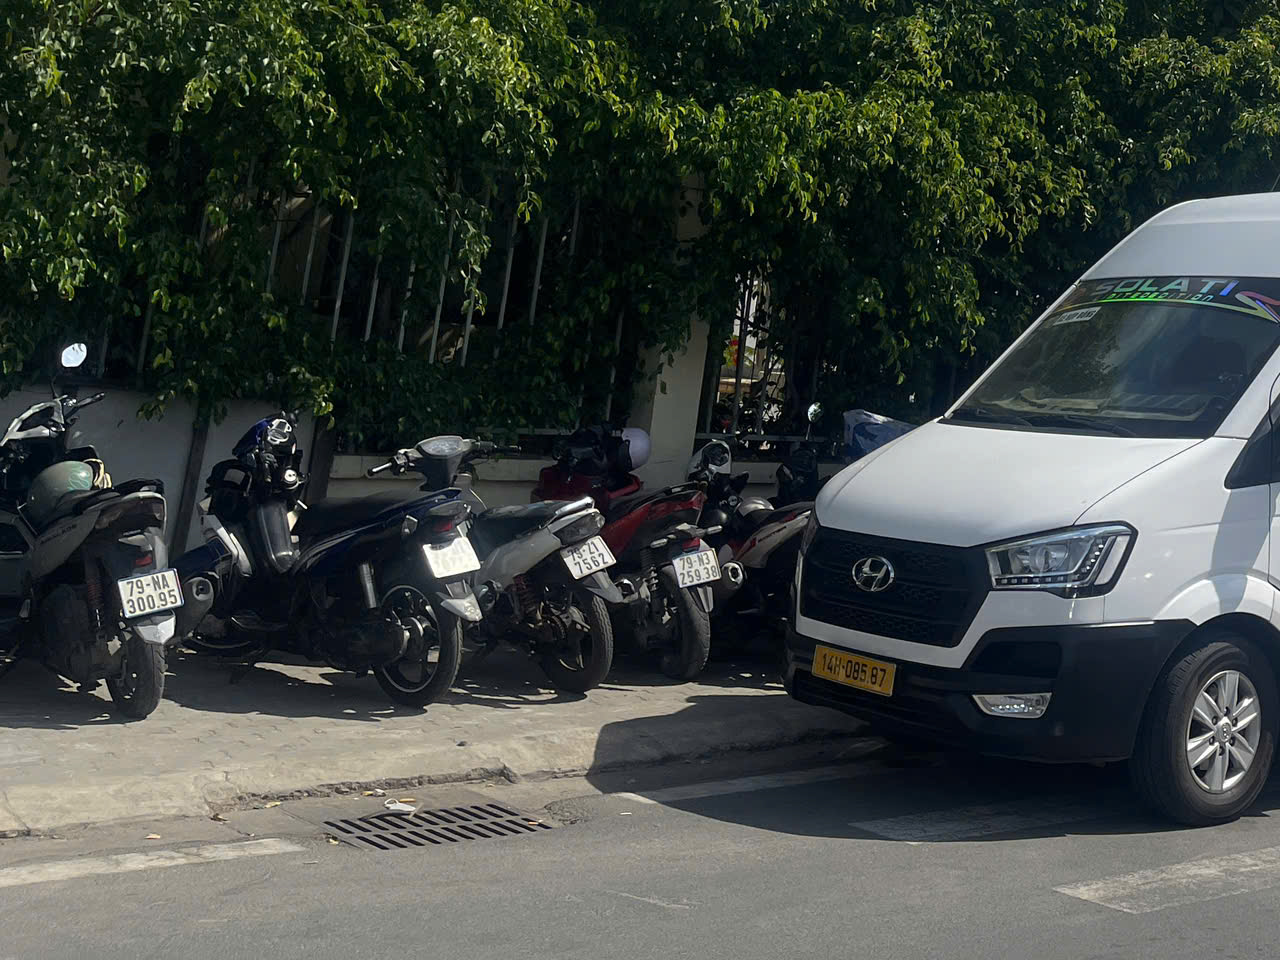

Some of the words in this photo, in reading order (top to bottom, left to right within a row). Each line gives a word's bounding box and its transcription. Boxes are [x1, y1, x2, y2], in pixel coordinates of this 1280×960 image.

[1095, 277, 1240, 297] SOLATI
[574, 553, 608, 574] 7562
[680, 552, 710, 571] 79-N3
[126, 573, 170, 597] 79-NA
[680, 565, 717, 585] 259.38
[126, 589, 178, 614] 300.95
[821, 652, 887, 688] 14H-085.87
